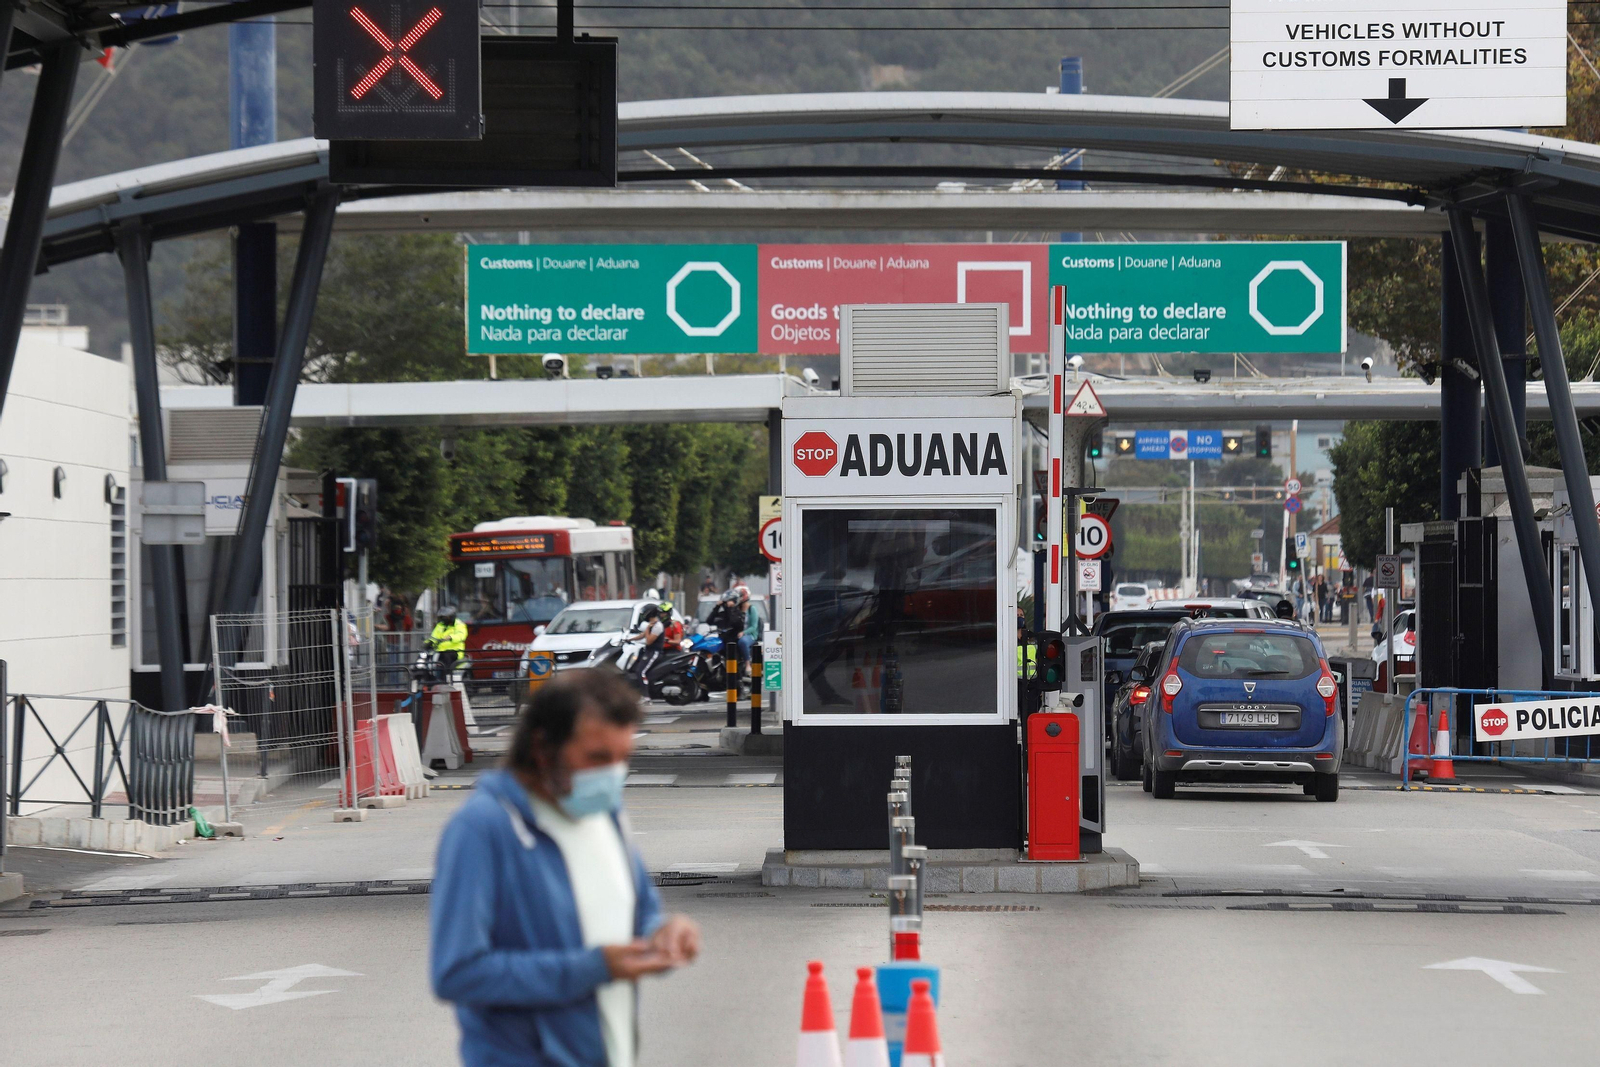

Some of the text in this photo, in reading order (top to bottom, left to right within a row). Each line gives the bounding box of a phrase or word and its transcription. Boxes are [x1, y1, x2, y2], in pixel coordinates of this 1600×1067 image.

[1285, 21, 1505, 40] VEHICLES WITHOUT
[1262, 48, 1527, 68] CUSTOMS FORMALITIES
[480, 257, 534, 270] Customs
[543, 257, 587, 270] Douane
[596, 257, 640, 270] Aduana
[771, 257, 824, 270] Customs
[833, 257, 877, 270] Douane
[886, 256, 930, 270] Aduana
[1062, 256, 1115, 269] Customs
[1124, 256, 1168, 269] Douane
[1178, 256, 1222, 269] Aduana
[480, 304, 646, 324] Nothing to declare
[771, 303, 828, 320] Goods
[1065, 302, 1227, 324] Nothing to declare
[480, 325, 629, 344] Nada para declarar
[771, 324, 831, 344] Objetos
[1065, 323, 1210, 344] Nada para declarar
[1141, 445, 1166, 453] AHEAD
[1196, 435, 1213, 445] NO
[796, 432, 1008, 477] STOP ADUANA
[1187, 446, 1222, 454] STOPPING
[768, 530, 782, 549] 1
[1080, 525, 1103, 546] 10
[1228, 713, 1277, 723] 7149 LHC
[1483, 718, 1506, 727] STOP
